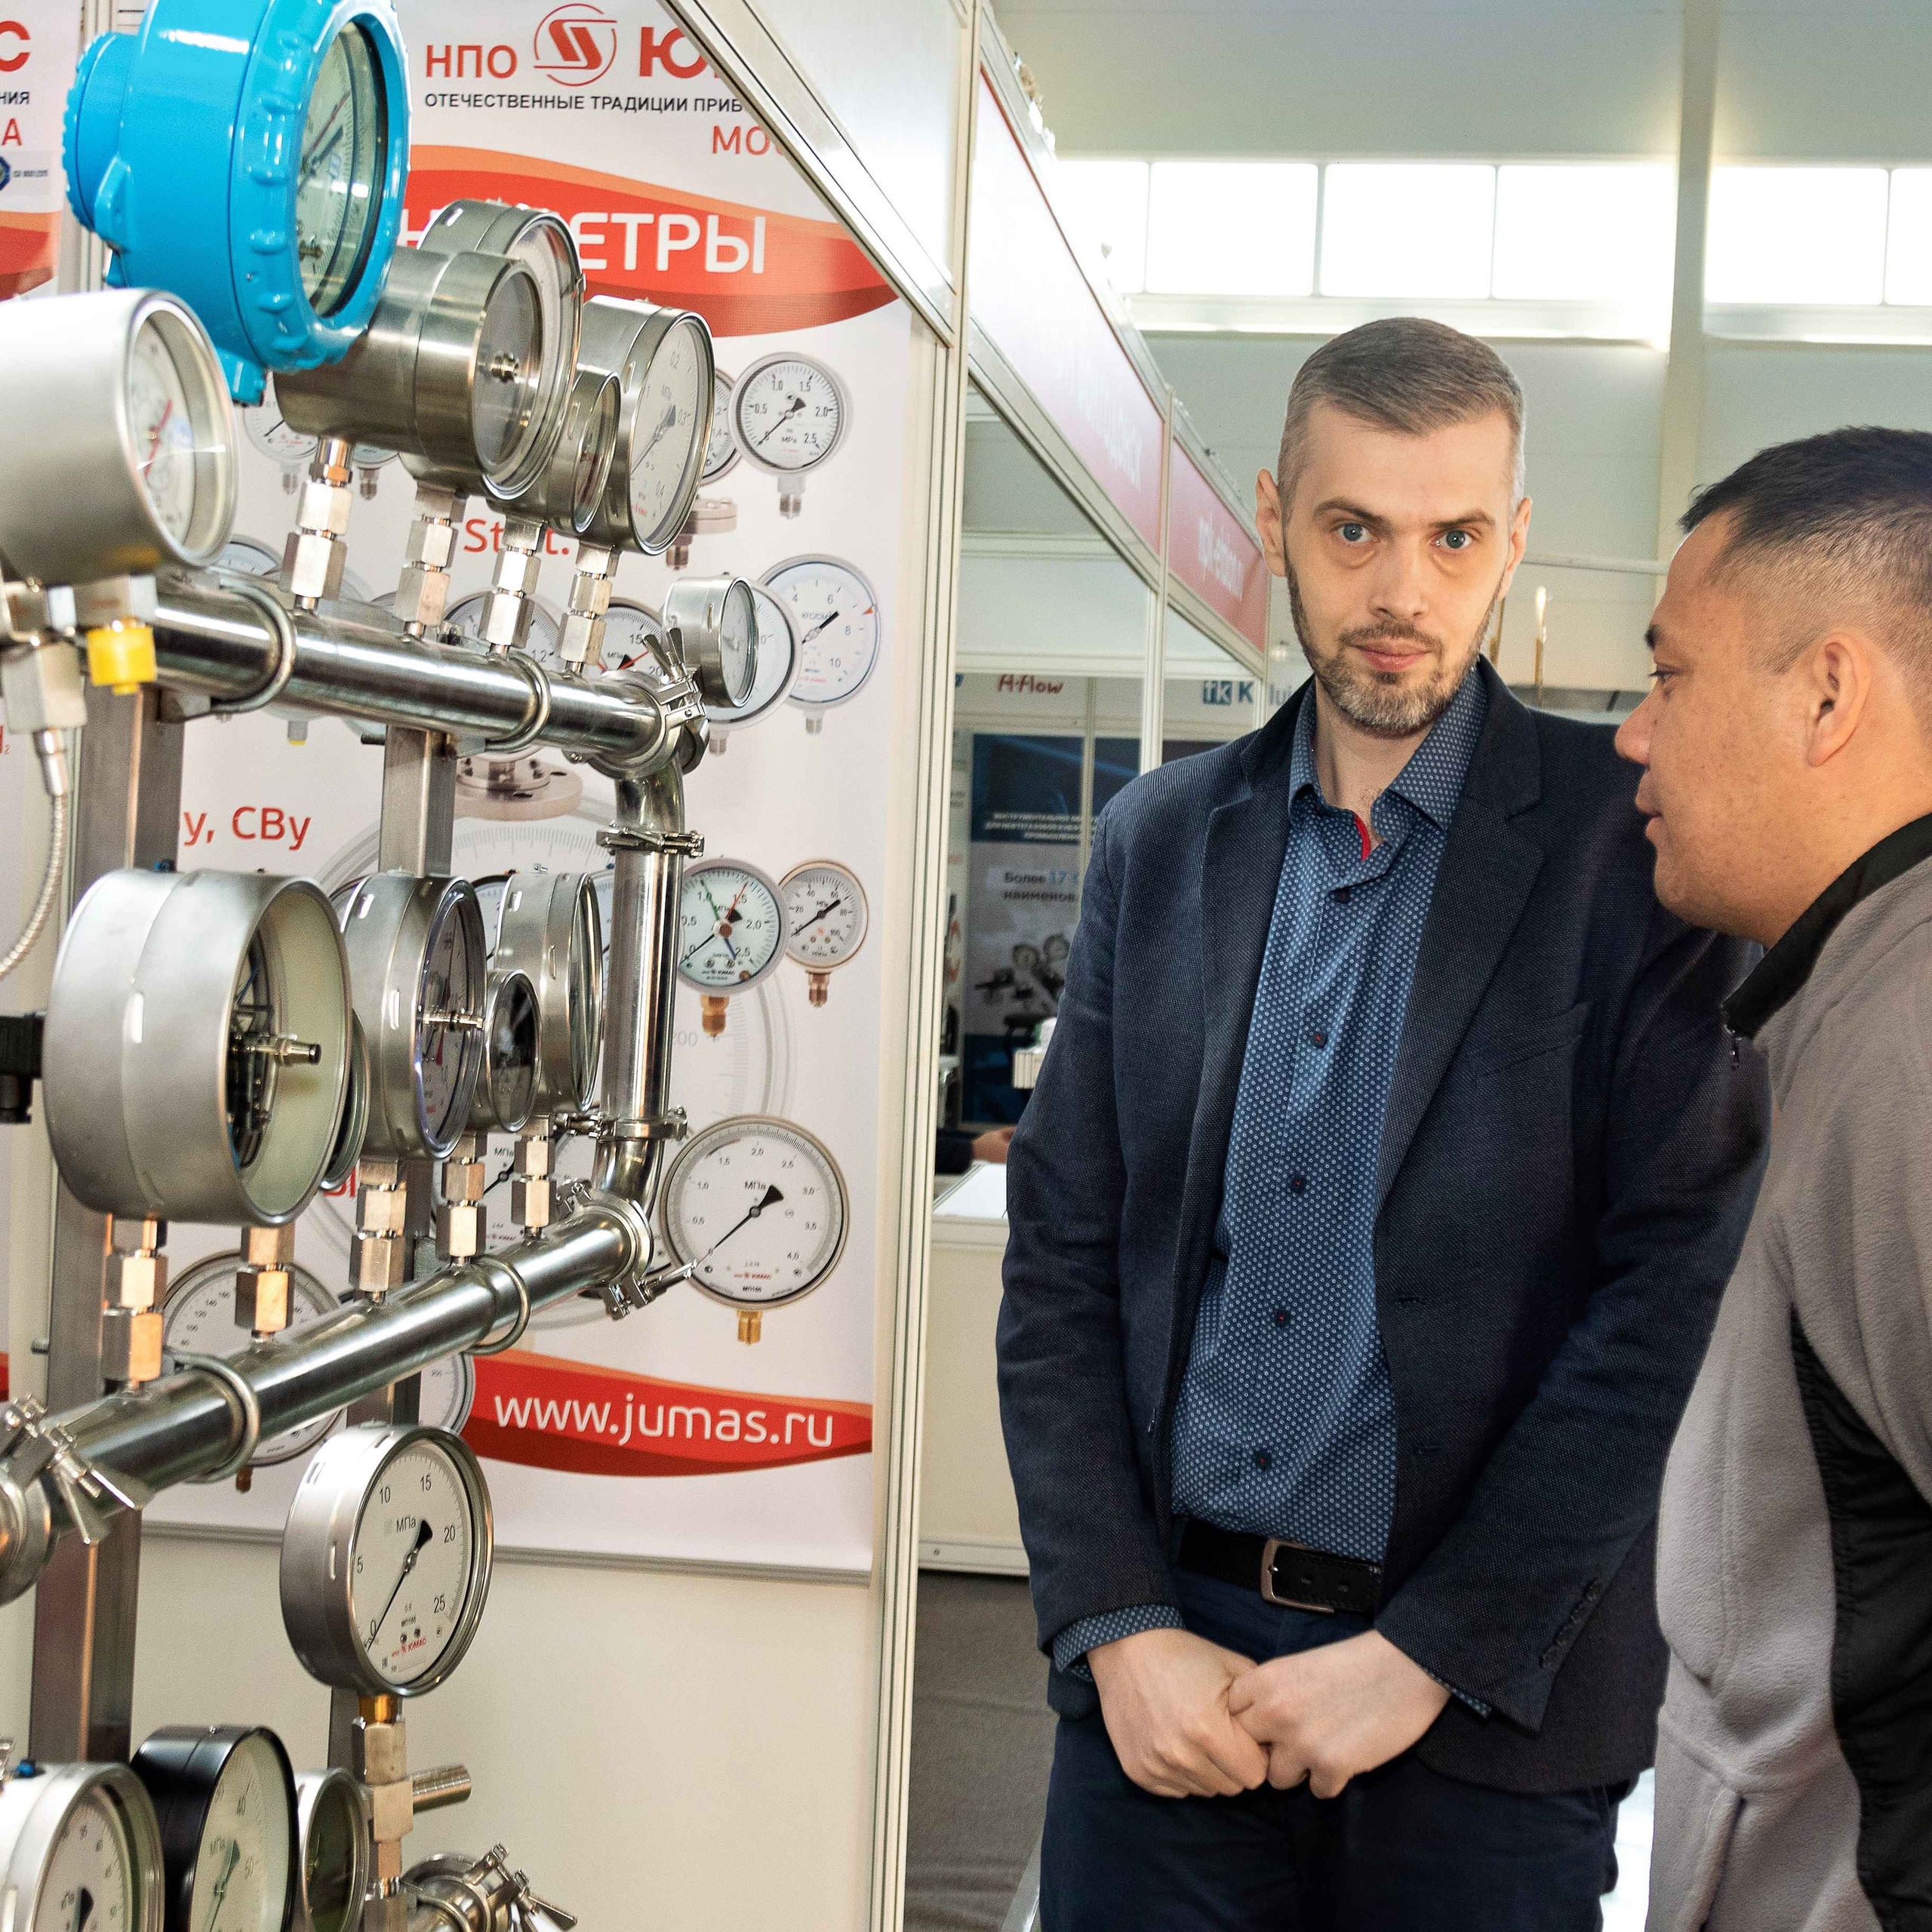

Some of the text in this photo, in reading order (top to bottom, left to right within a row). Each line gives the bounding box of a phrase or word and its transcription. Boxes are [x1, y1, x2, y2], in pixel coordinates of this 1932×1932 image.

[426, 26, 719, 78] НПО Ю
[425, 93, 585, 110] ОТЕЧЕСТВЕННЫЕ
[591, 96, 688, 113] ТРАДИЦИИ
[712, 125, 783, 156] МО
[494, 1392, 833, 1447] www.jumas.ru
[420, 1475, 432, 1492] 15
[379, 1487, 391, 1504] 10
[396, 1517, 416, 1534] МПа
[444, 1525, 456, 1543] 20
[356, 1555, 364, 1574] 5
[433, 1594, 446, 1614] 25
